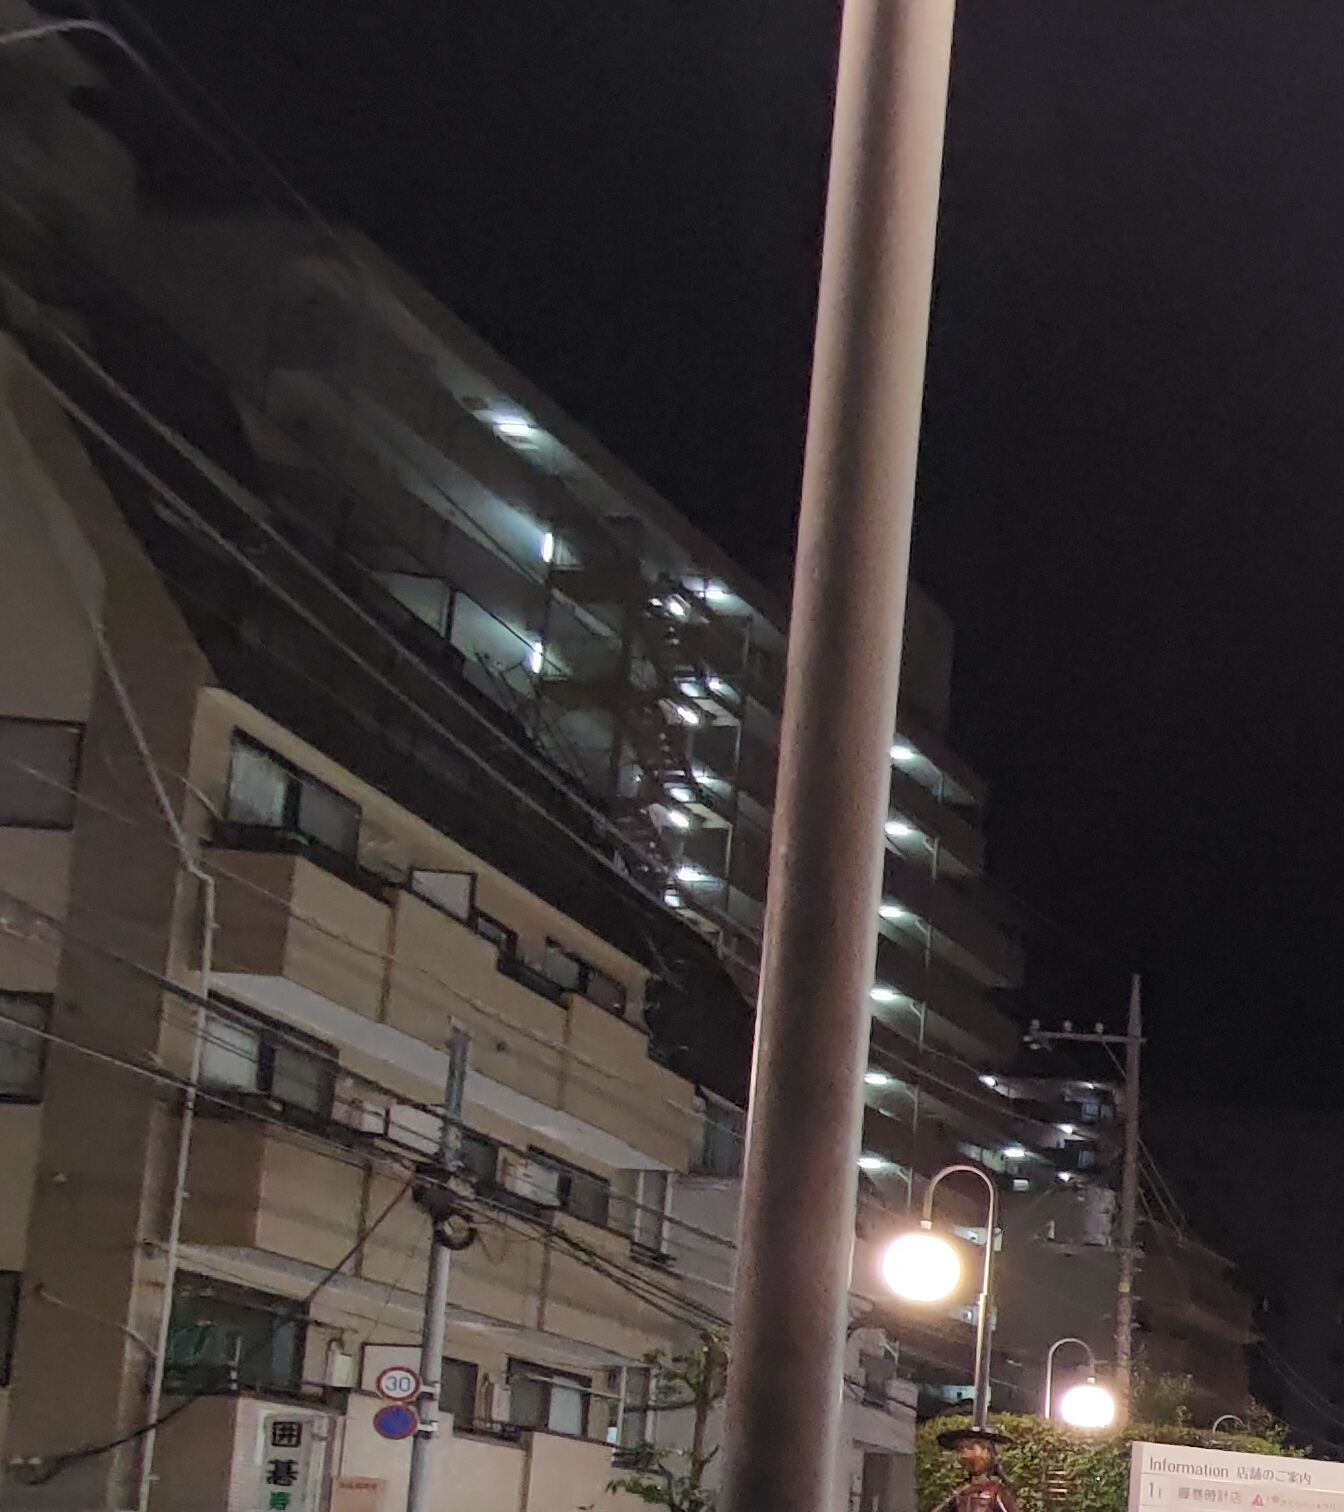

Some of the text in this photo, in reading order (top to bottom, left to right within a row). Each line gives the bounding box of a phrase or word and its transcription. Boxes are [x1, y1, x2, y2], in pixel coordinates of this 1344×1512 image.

[385, 1375, 410, 1392] 30
[1150, 1456, 1312, 1486] Information 店舗のご案内
